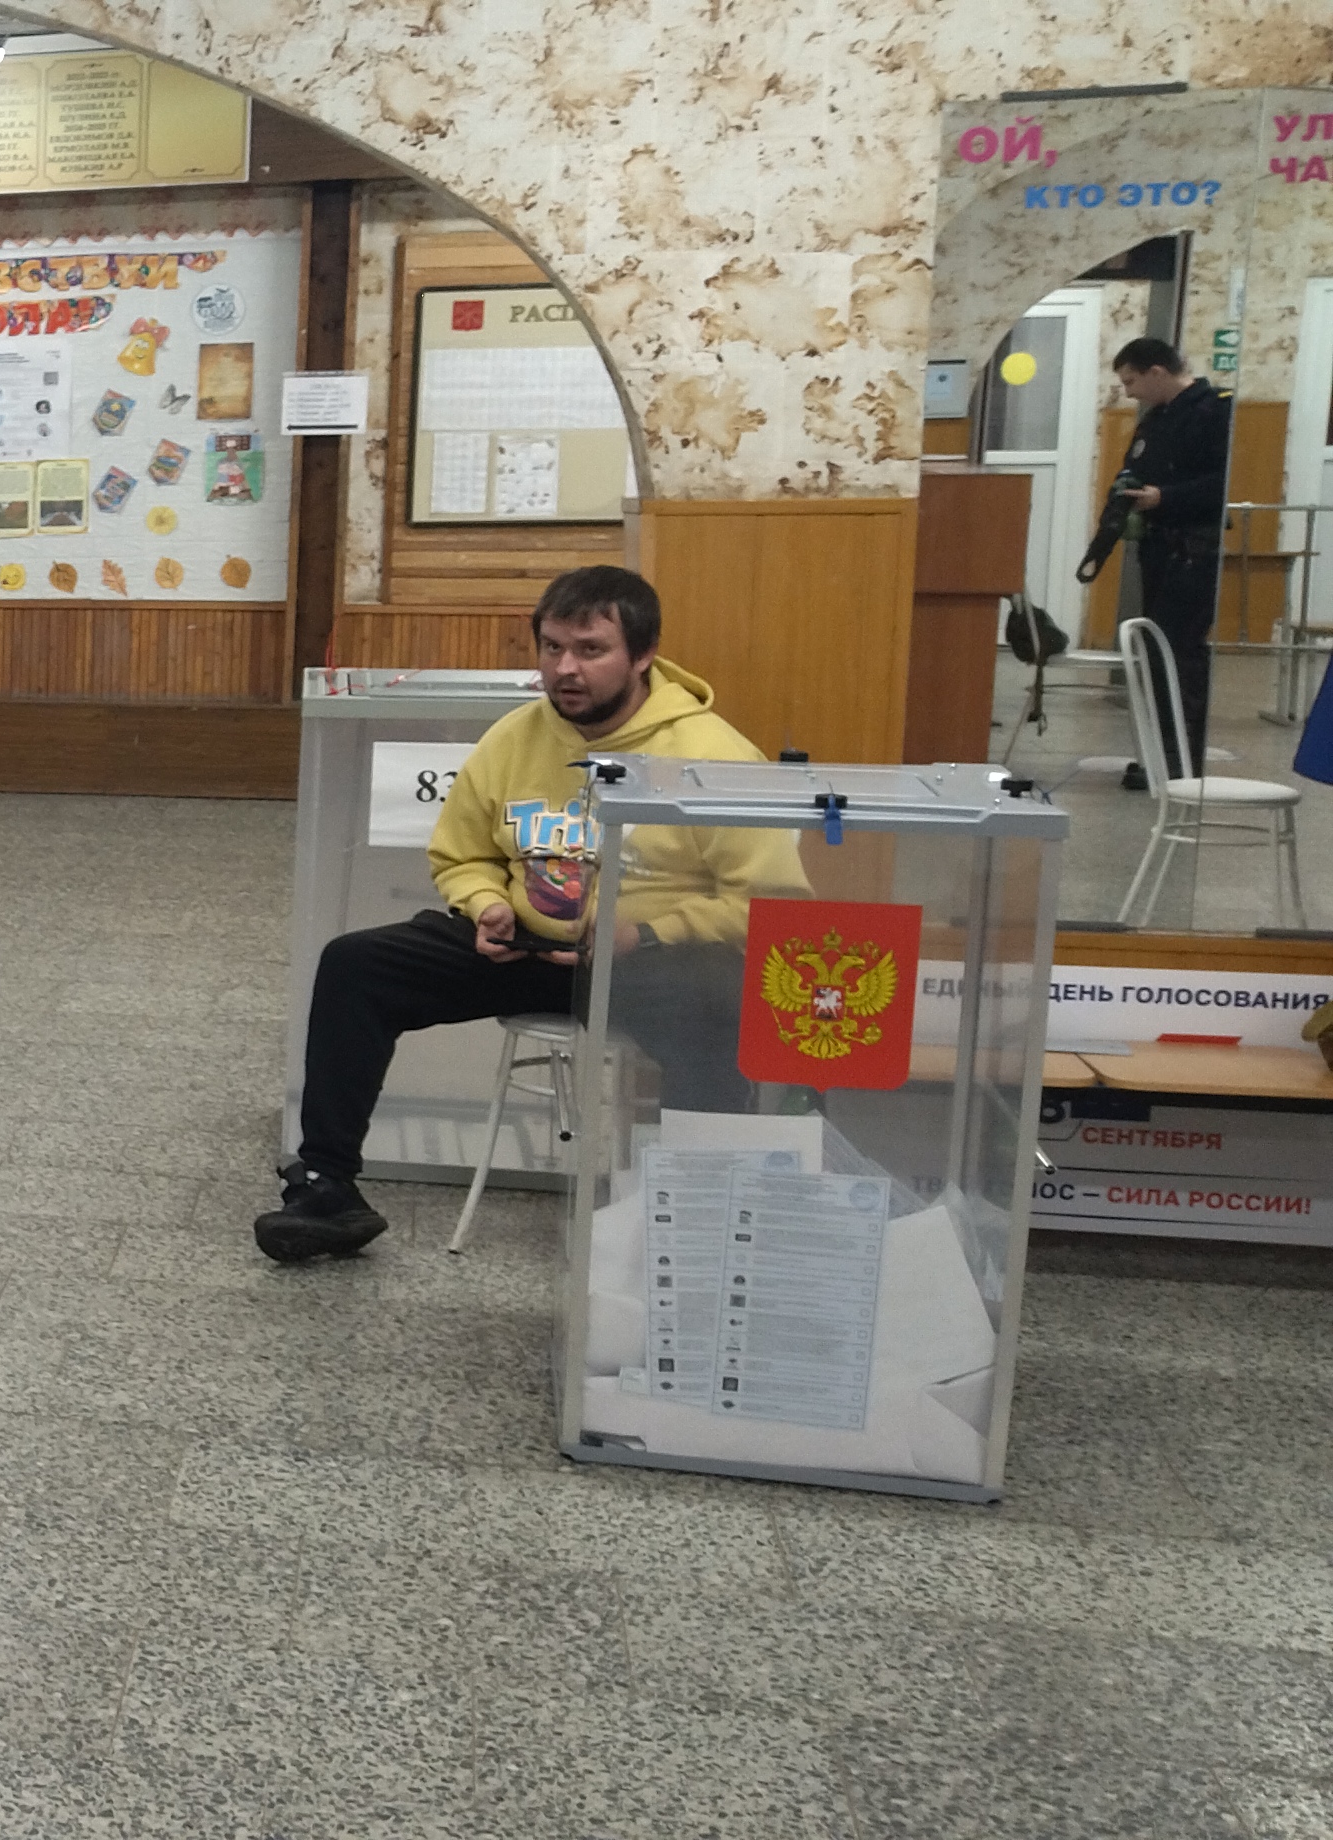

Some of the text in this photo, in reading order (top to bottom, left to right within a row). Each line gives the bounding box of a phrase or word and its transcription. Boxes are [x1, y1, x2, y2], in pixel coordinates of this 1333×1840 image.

[958, 116, 1059, 168] ОЙ,
[1024, 180, 1222, 209] КТО ЭТО?
[1047, 982, 1113, 1003] ДЕНЬ
[1121, 985, 1330, 1011] ГОЛОСОВАНИЯ
[1081, 1126, 1223, 1152] СЕНТЯБРЯ
[1106, 1184, 1181, 1208] СИЛА
[1188, 1189, 1312, 1215] РОССИИ!
